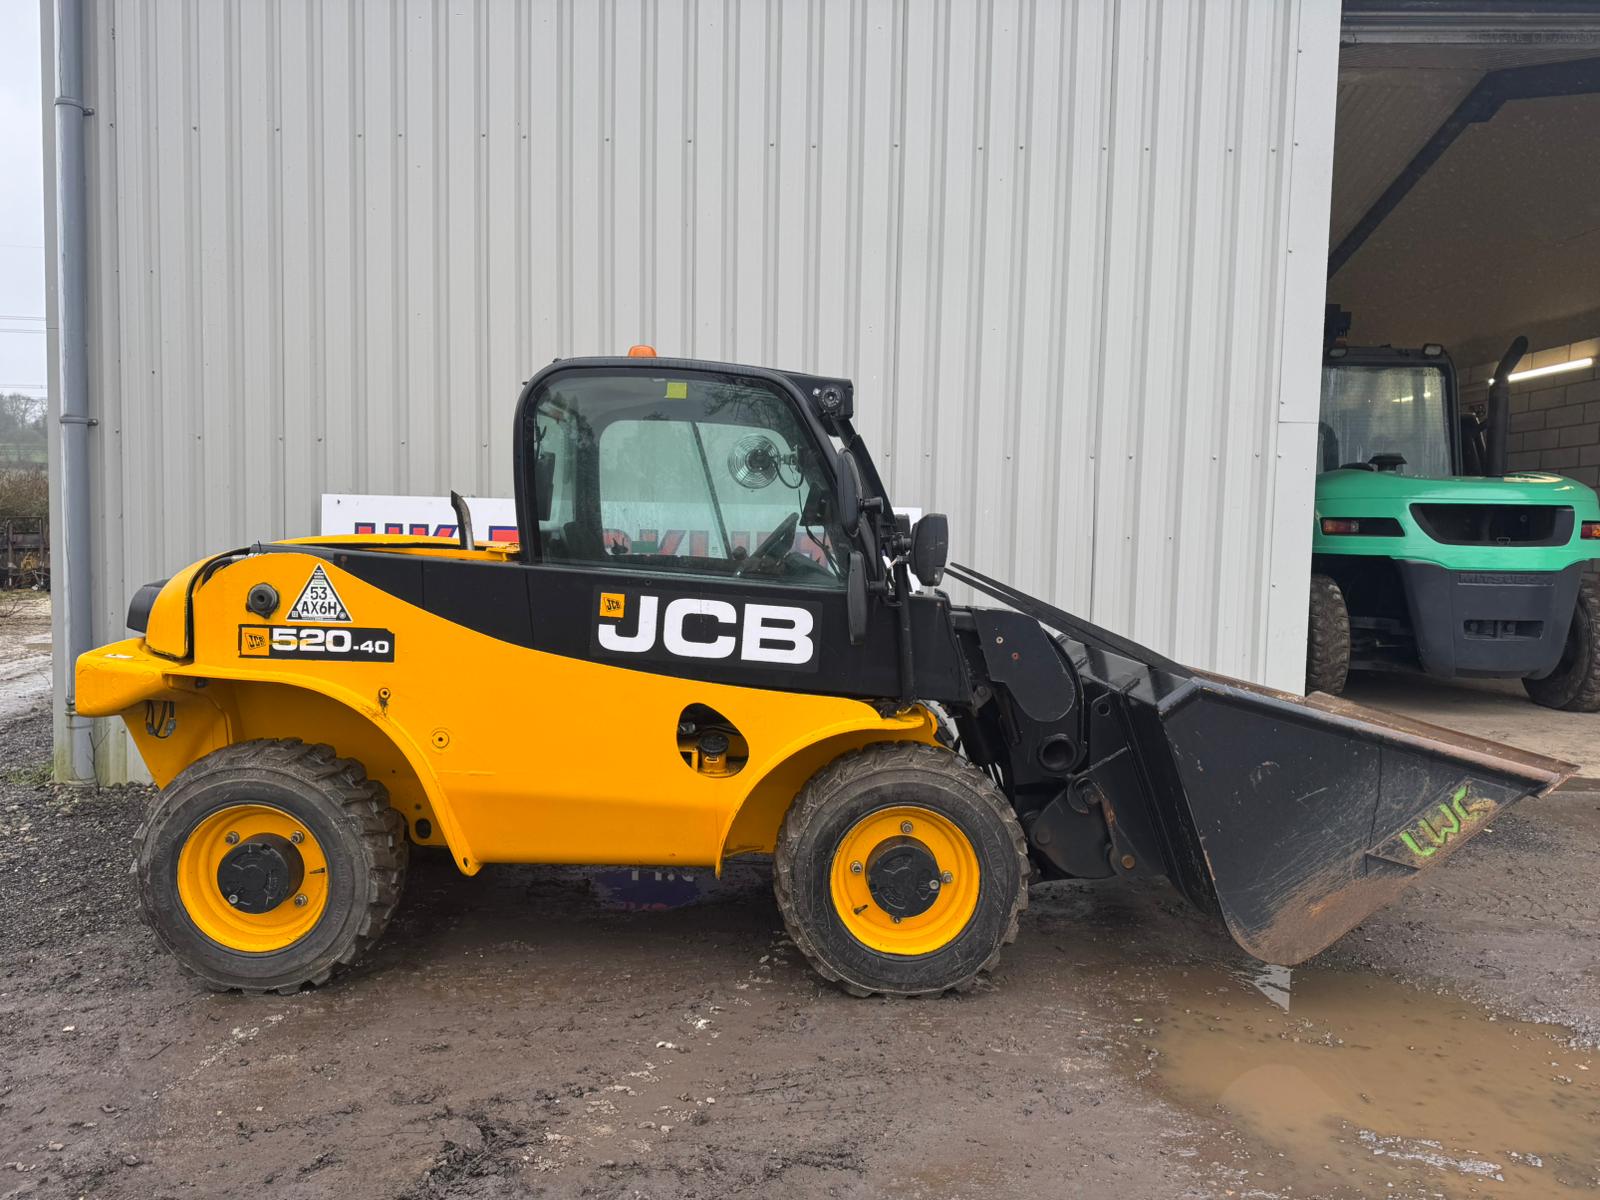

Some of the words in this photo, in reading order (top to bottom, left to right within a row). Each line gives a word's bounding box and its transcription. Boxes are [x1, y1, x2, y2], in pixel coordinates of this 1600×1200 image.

[310, 586, 327, 600] 53
[301, 600, 337, 615] AX6H
[606, 597, 621, 610] JCB
[597, 594, 814, 665] JCB
[248, 634, 266, 648] JCB
[271, 627, 390, 654] 520-40
